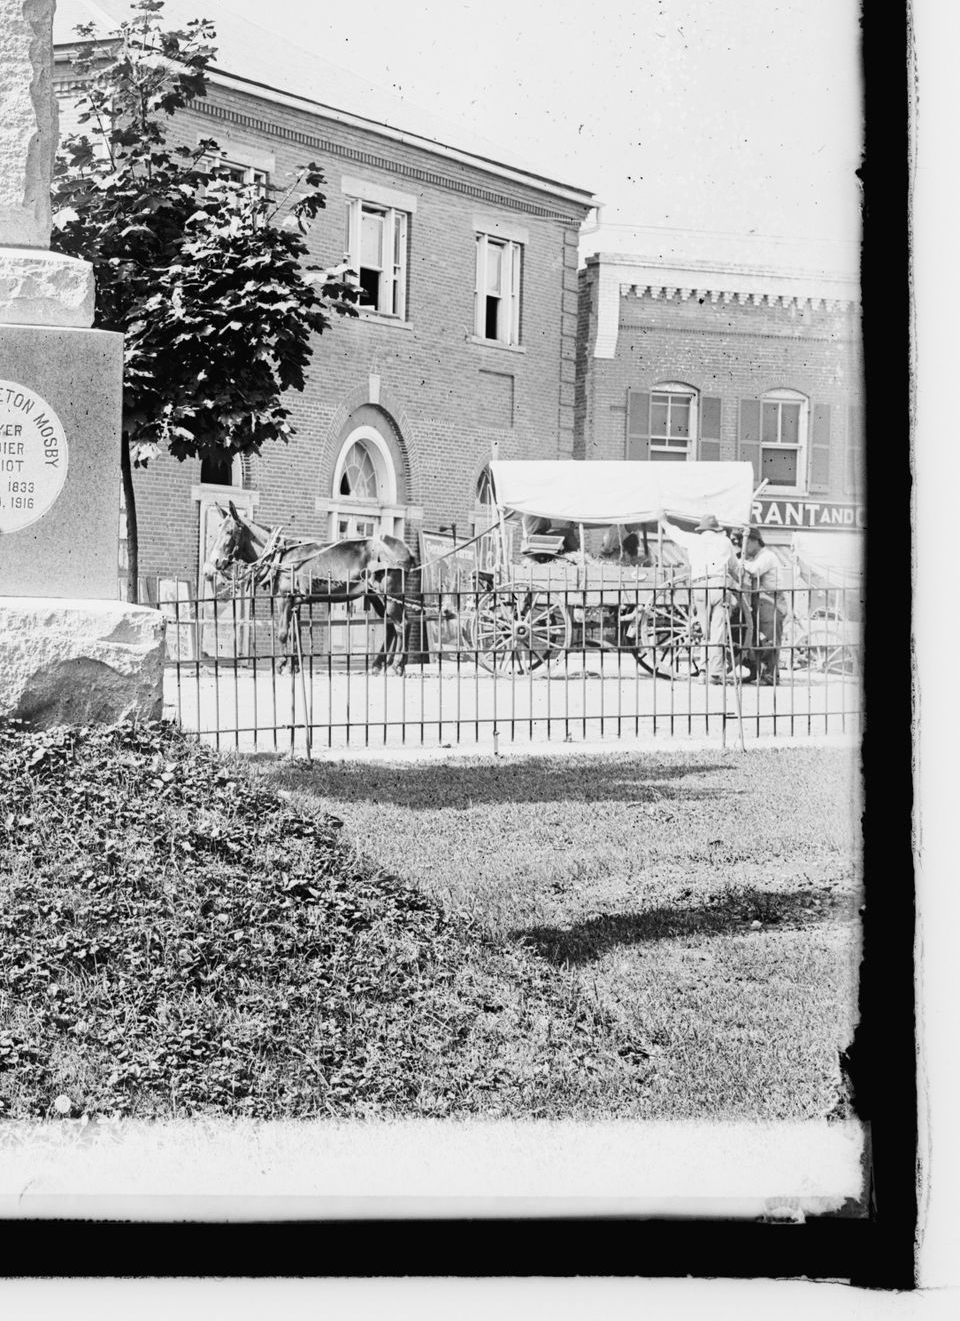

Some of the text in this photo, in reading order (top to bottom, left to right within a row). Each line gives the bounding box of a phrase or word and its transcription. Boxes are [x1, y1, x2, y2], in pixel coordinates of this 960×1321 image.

[33, 412, 59, 469] MOSBY
[8, 481, 35, 494] 1833
[10, 497, 35, 509] 1916
[820, 507, 854, 524] AND
